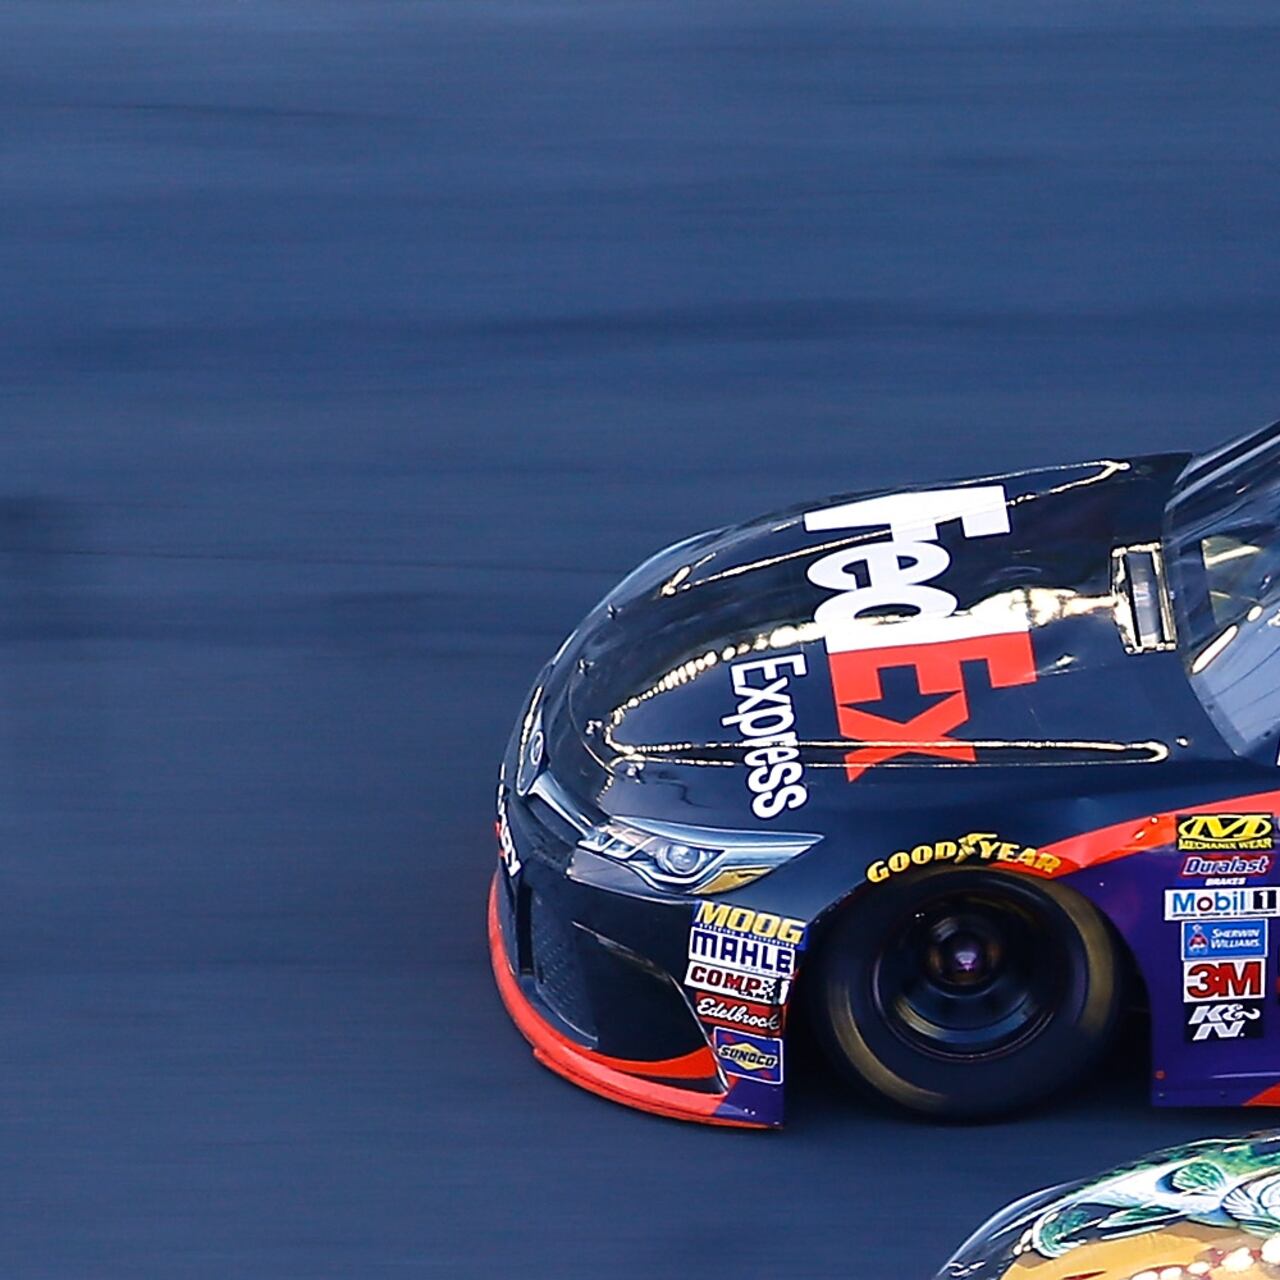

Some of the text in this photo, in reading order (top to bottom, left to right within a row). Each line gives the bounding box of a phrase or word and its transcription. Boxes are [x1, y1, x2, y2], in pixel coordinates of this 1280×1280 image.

[803, 484, 1038, 783] FedEx
[720, 653, 808, 818] Express
[1178, 836, 1273, 850] MECHANIX WEAR
[867, 836, 1061, 883] GOODYEAR
[1182, 855, 1270, 876] Duralast
[1172, 890, 1246, 913] Mobil
[695, 900, 808, 944] MOOG
[1211, 927, 1260, 939] SHERWIN
[691, 930, 793, 974] MAHLE
[690, 965, 763, 994] COMP
[1186, 961, 1262, 998] 3M
[696, 998, 781, 1030] Edelbrock
[719, 1045, 778, 1068] SUNOCO
